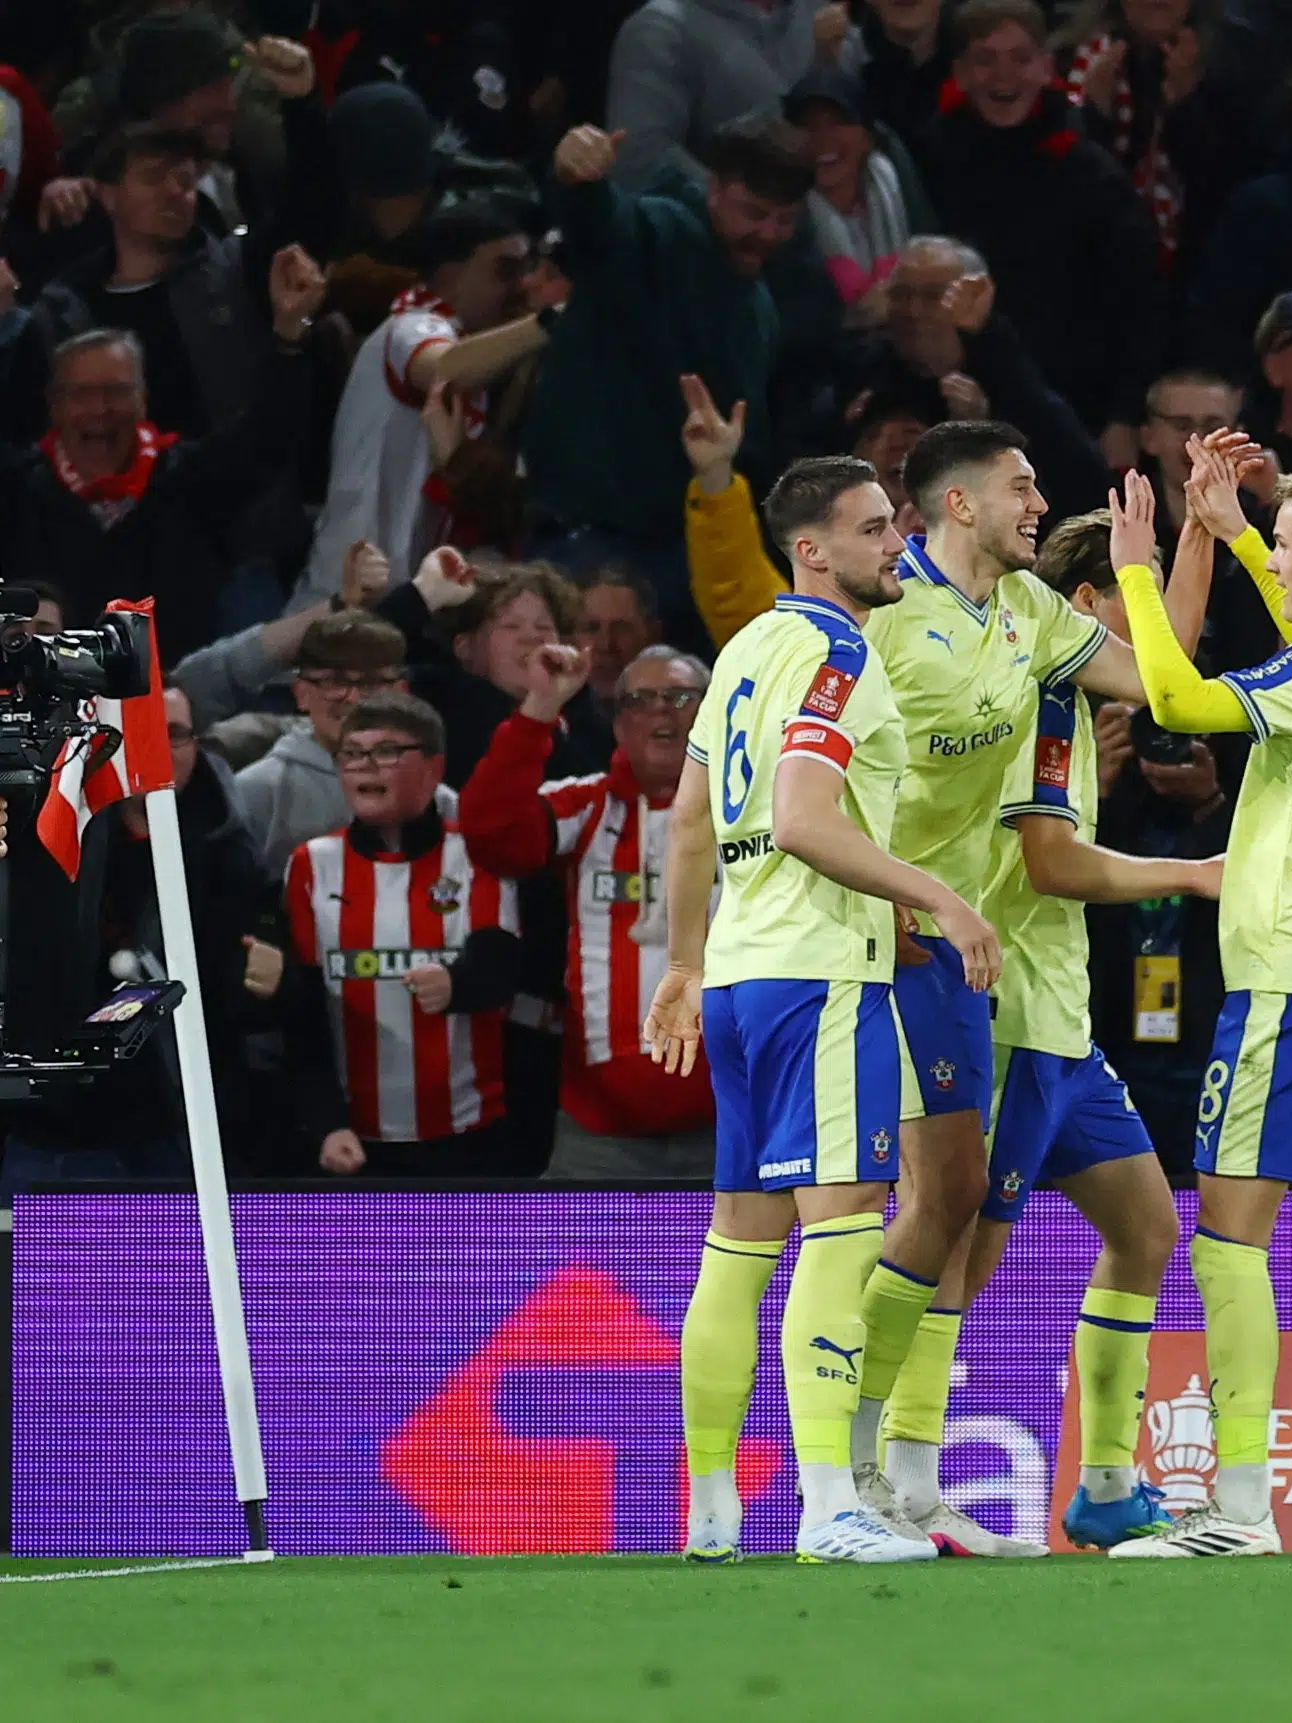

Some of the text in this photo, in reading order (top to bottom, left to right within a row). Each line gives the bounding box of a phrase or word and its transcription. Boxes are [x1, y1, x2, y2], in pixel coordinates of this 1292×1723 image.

[723, 676, 756, 825] 6
[1198, 1060, 1229, 1123] 8
[816, 1366, 858, 1385] SFC
